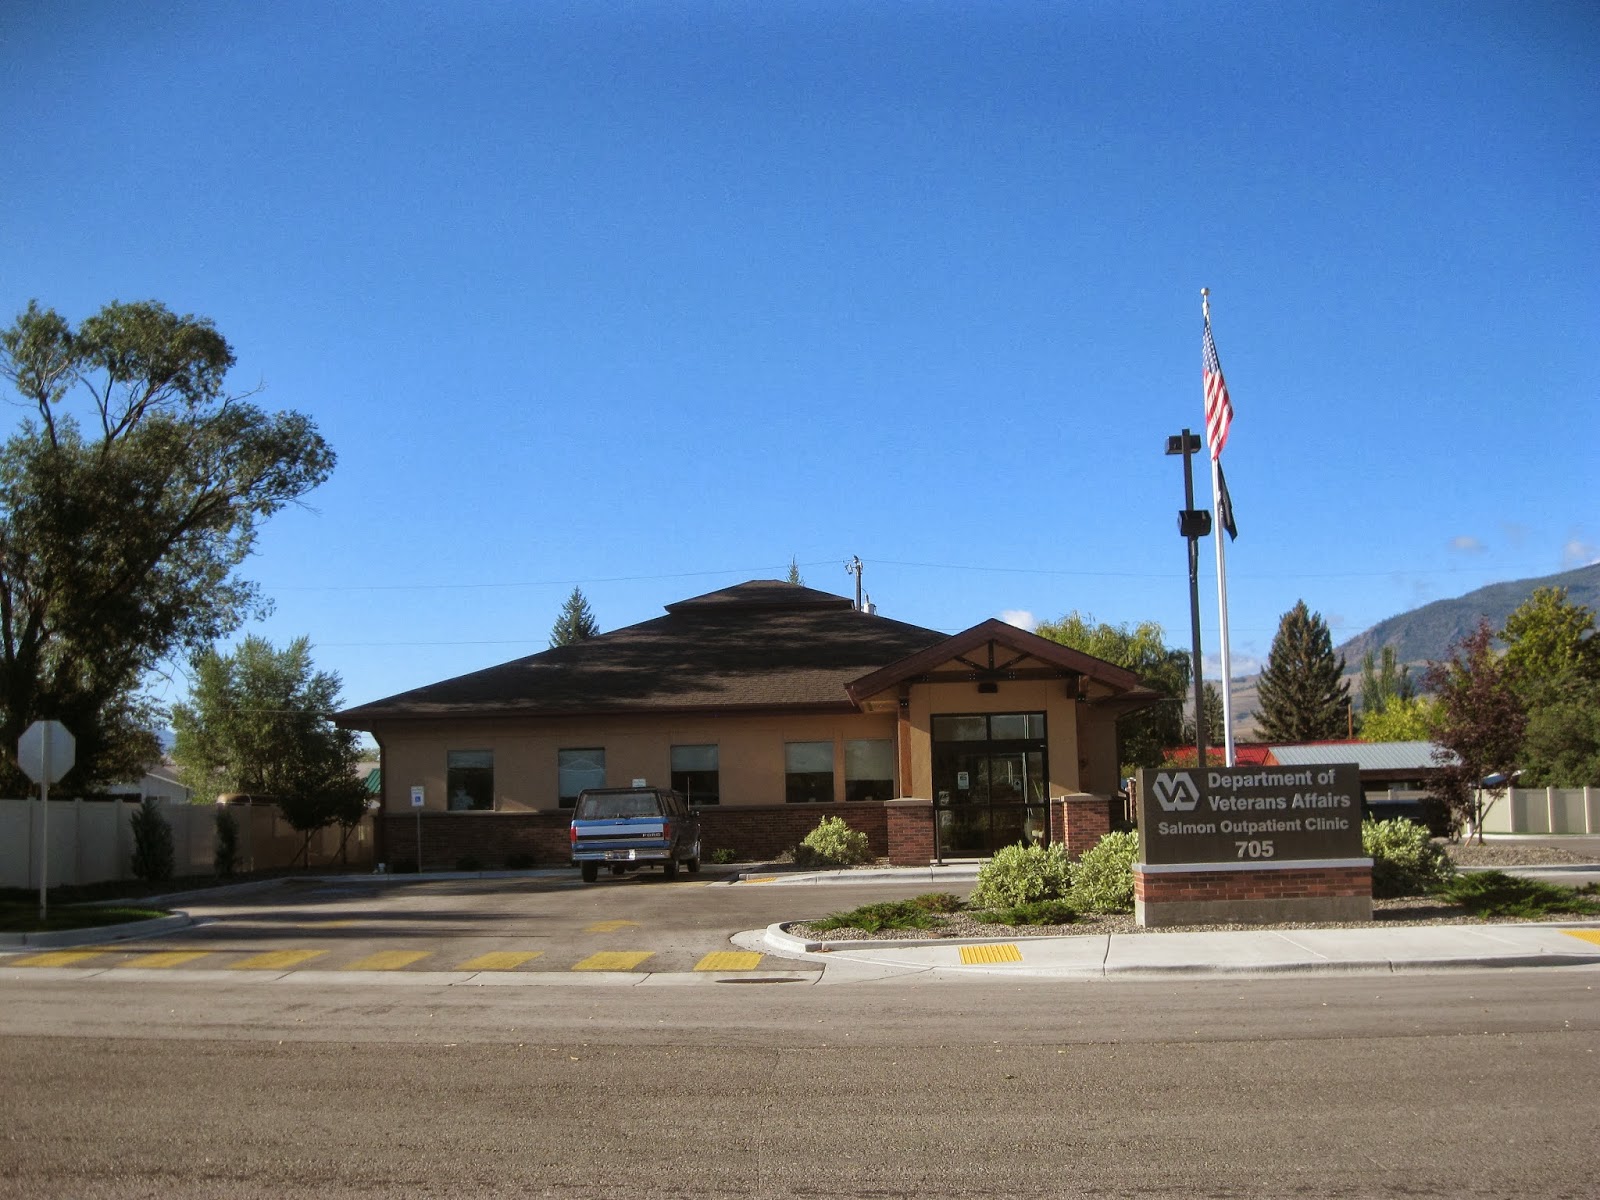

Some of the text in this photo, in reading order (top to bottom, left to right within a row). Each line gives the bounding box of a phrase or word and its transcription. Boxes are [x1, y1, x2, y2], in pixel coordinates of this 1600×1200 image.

[1208, 769, 1336, 791] Department of
[1208, 793, 1351, 811] Veterans Affairs
[1158, 817, 1349, 835] Salmon Outpatient Clinic
[1235, 840, 1274, 858] 705
